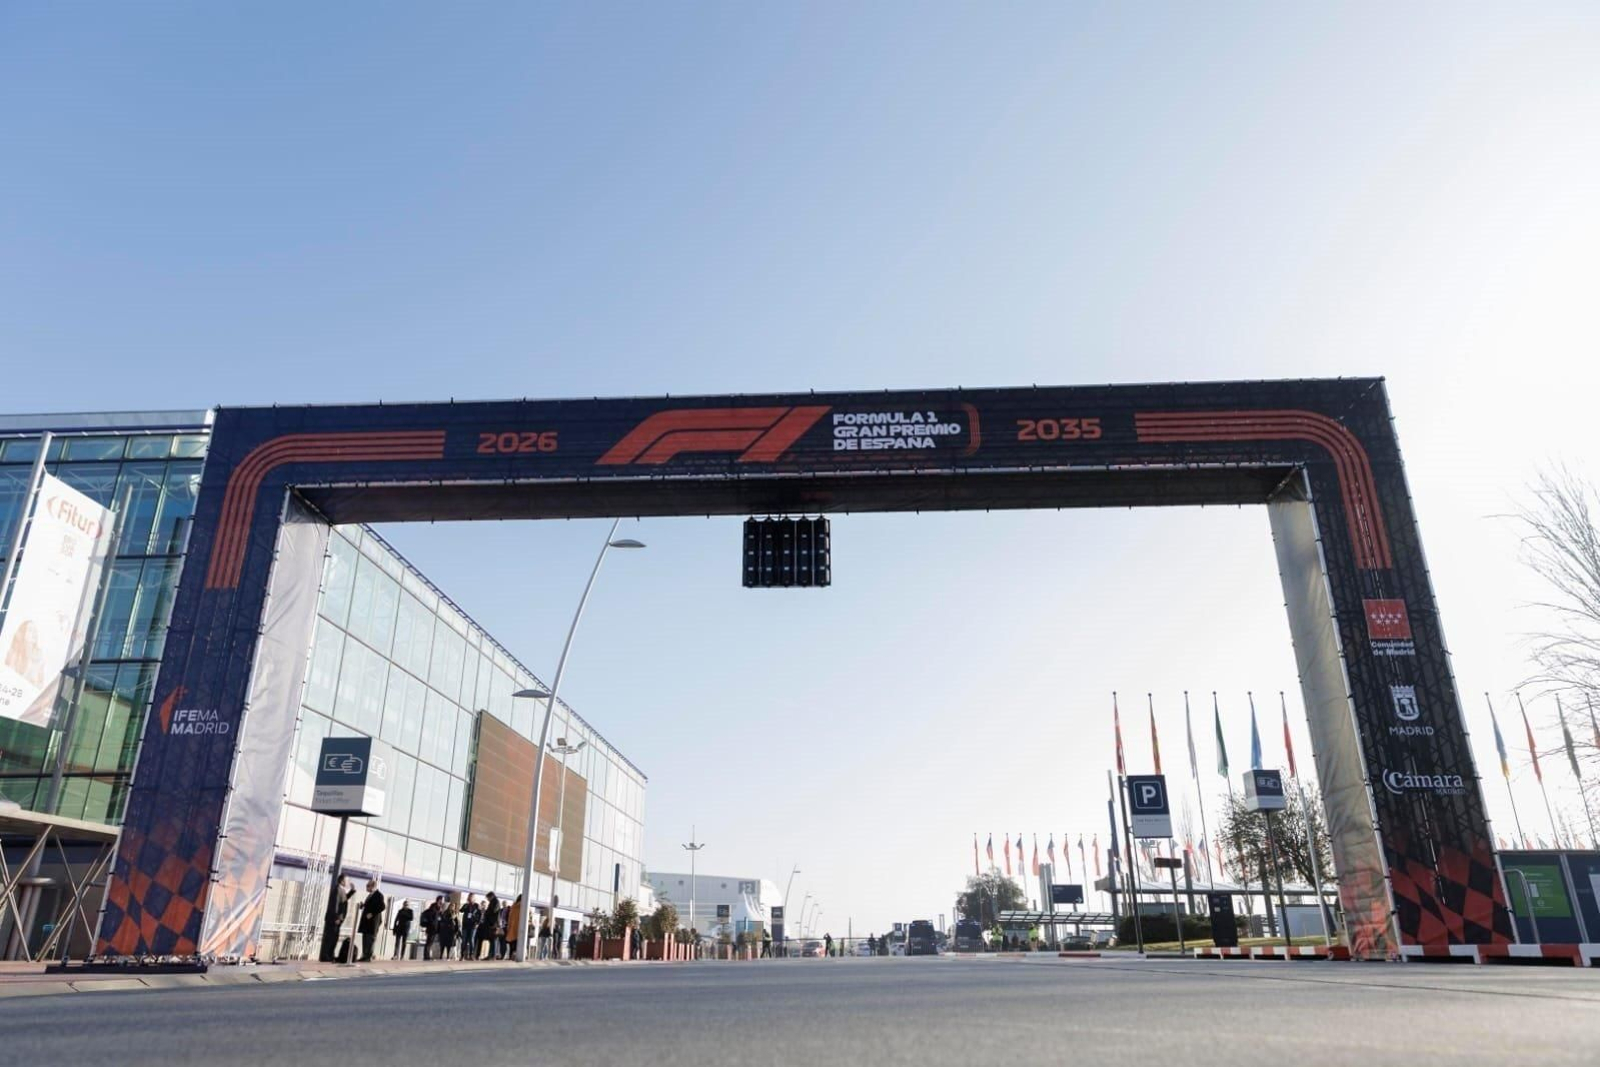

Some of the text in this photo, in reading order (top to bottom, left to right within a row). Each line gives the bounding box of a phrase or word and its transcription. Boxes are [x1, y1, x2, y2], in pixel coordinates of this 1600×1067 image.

[833, 411, 938, 425] FORMULA 1
[595, 406, 833, 464] F1
[833, 423, 961, 438] GRAN PREMIO
[1016, 418, 1102, 440] 2035
[477, 432, 559, 454] 2026
[833, 439, 858, 450] DE
[57, 500, 96, 535] Fitur
[1371, 641, 1414, 649] Comunidad
[174, 709, 219, 721] IFEMA
[170, 722, 230, 735] MADRID
[1388, 726, 1434, 736] MADRID
[1387, 770, 1465, 788] Cámara
[1141, 785, 1157, 804] P
